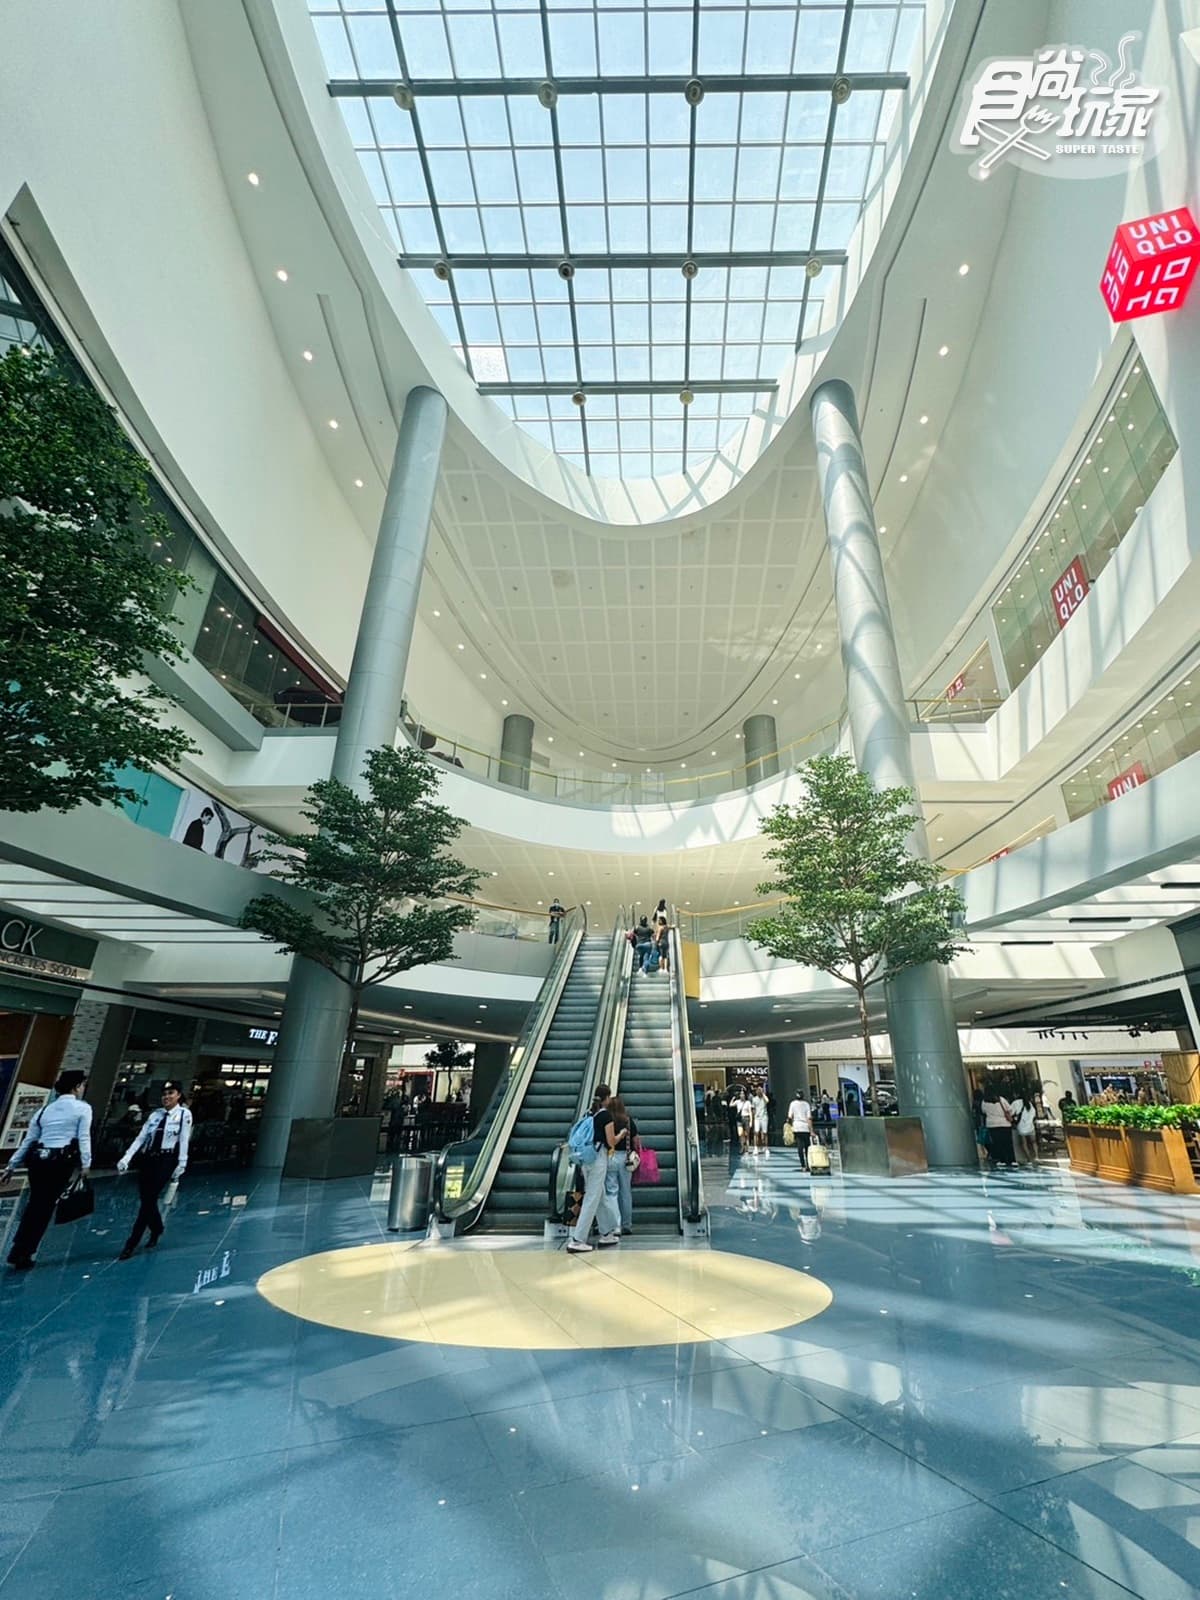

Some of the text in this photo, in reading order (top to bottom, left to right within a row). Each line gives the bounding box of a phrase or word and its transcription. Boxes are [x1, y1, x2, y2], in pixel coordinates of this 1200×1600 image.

[1128, 215, 1182, 239] UNI
[1136, 230, 1193, 256] QLO
[1055, 567, 1078, 603] UNI
[1060, 584, 1084, 620] QLO
[49, 962, 79, 978] SODA
[249, 1028, 268, 1039] THE
